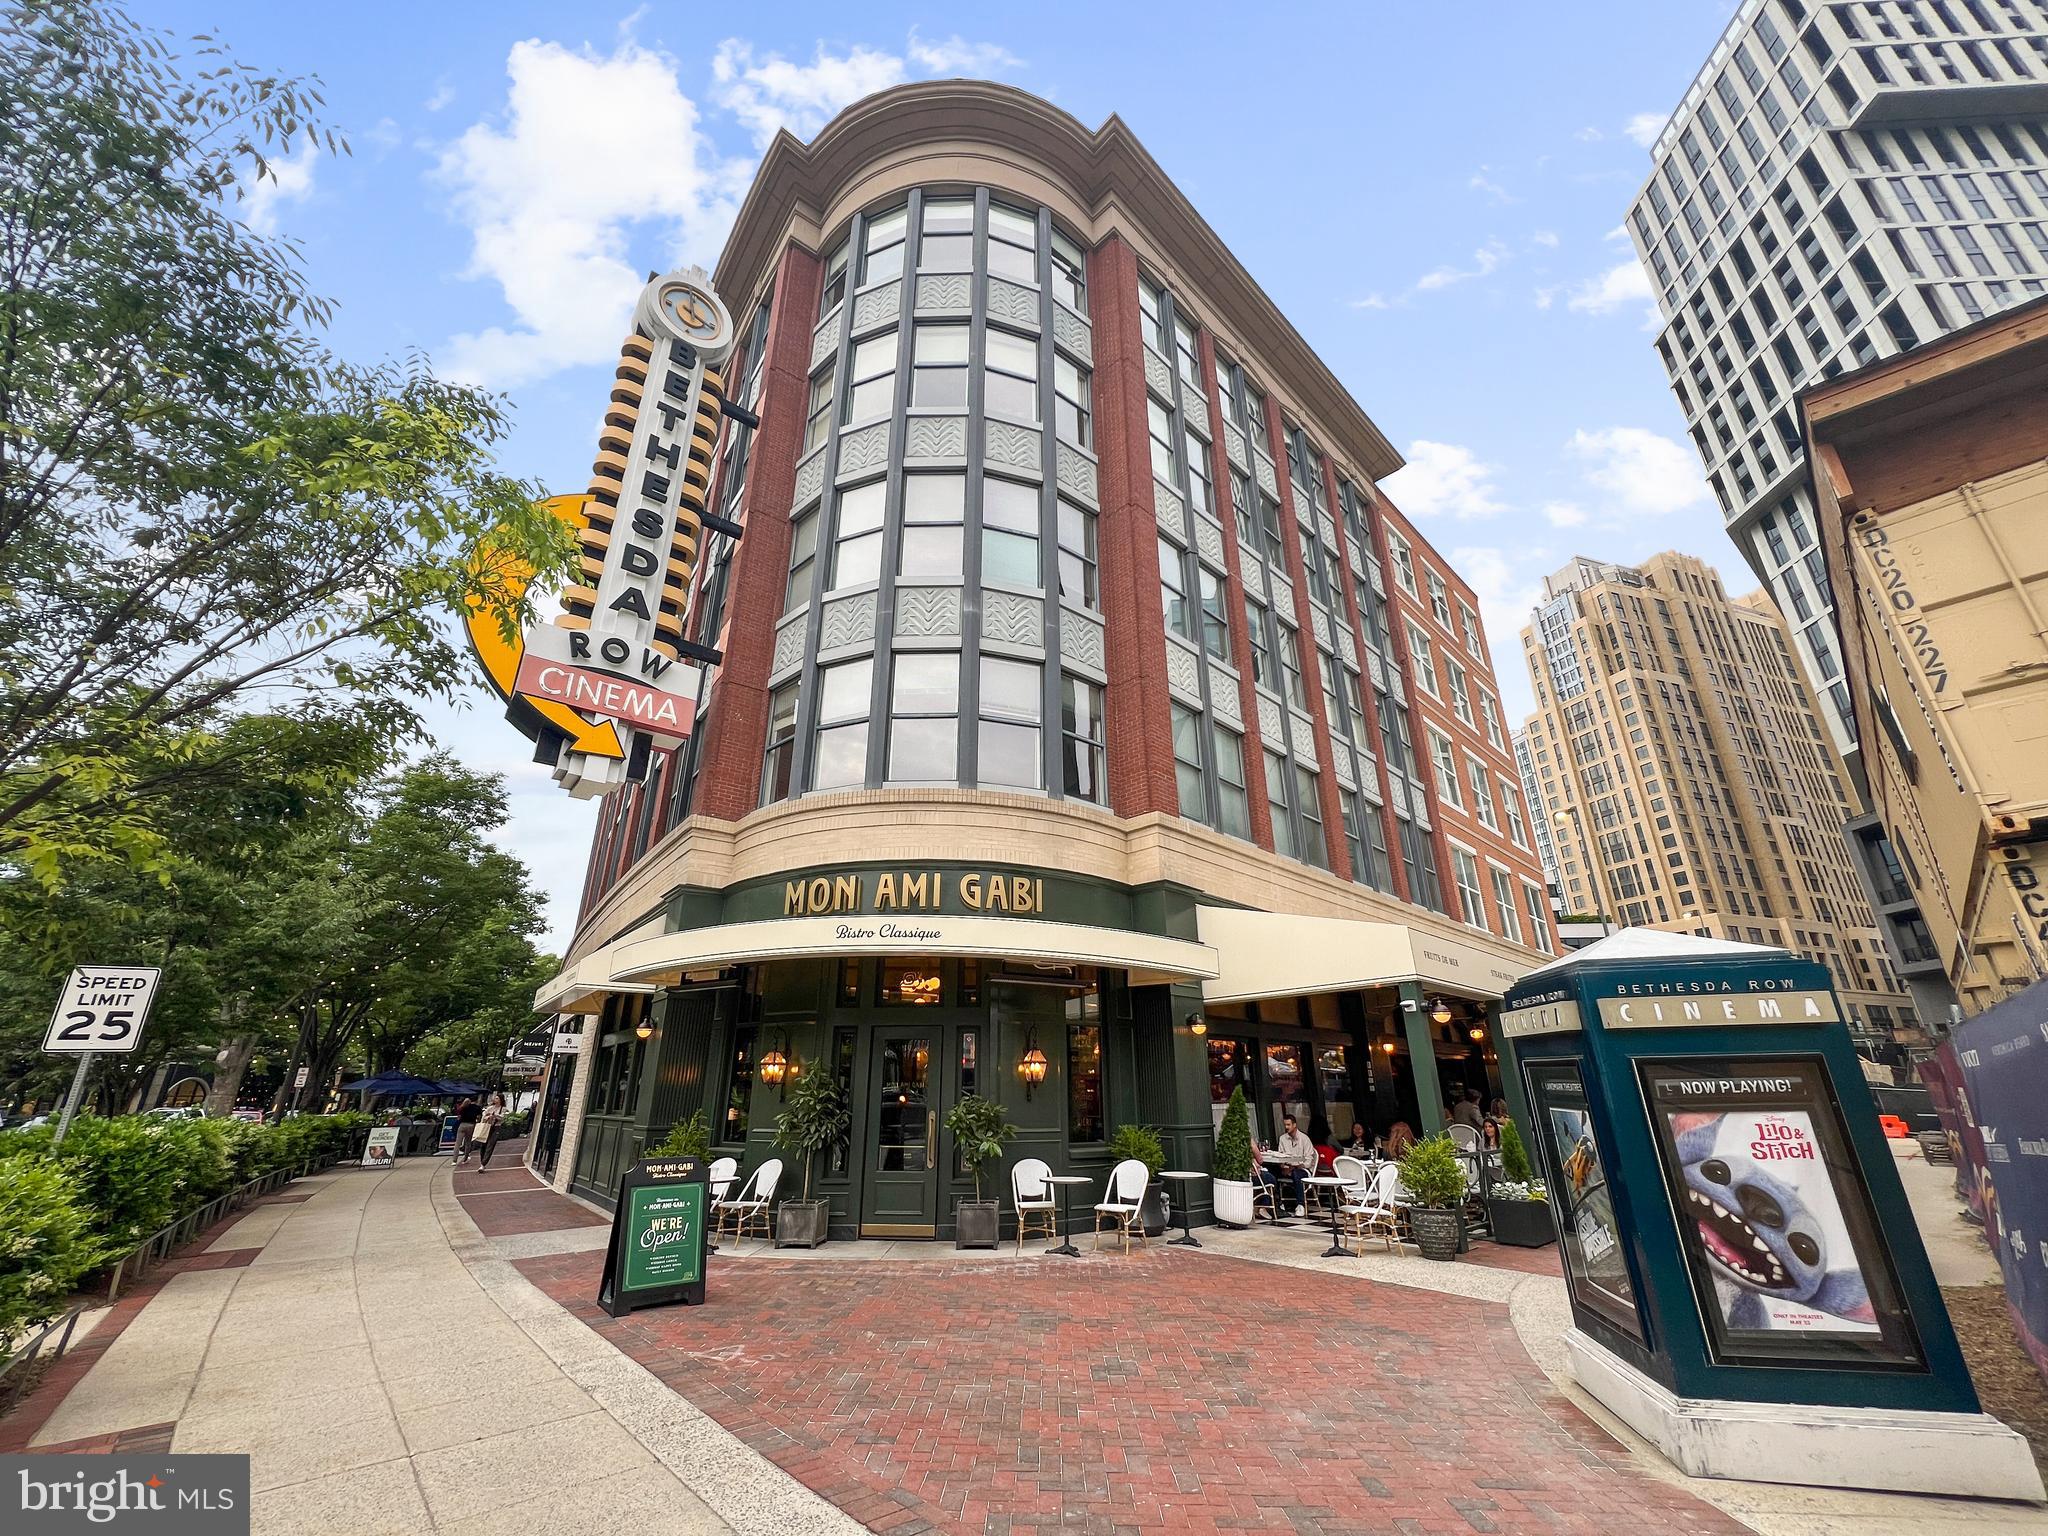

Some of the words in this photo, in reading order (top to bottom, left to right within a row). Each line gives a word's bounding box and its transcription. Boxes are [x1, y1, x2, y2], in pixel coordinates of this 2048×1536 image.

[608, 338, 698, 621] BETHESDA
[569, 632, 673, 680] ROW
[538, 667, 677, 726] CINEMA
[784, 875, 862, 915] MON
[874, 872, 941, 911] AMI
[959, 873, 1043, 914] GABI
[836, 924, 876, 939] Bistro
[879, 923, 942, 942] Classique
[1423, 950, 1441, 963] FRUITS
[1441, 955, 1449, 965] DE
[77, 976, 147, 989] SPEED
[1617, 981, 1732, 994] BETHESDA
[1749, 979, 1795, 990] ROW
[77, 993, 135, 1006] LIMIT
[1620, 997, 1822, 1022] CINEMA
[57, 1010, 134, 1041] 25
[1680, 1080, 1722, 1095] NOW
[1720, 1078, 1792, 1094] PLAYING!
[1794, 1128, 1804, 1139] &
[651, 1216, 683, 1231] WE'RE
[640, 1222, 690, 1253] Open!
